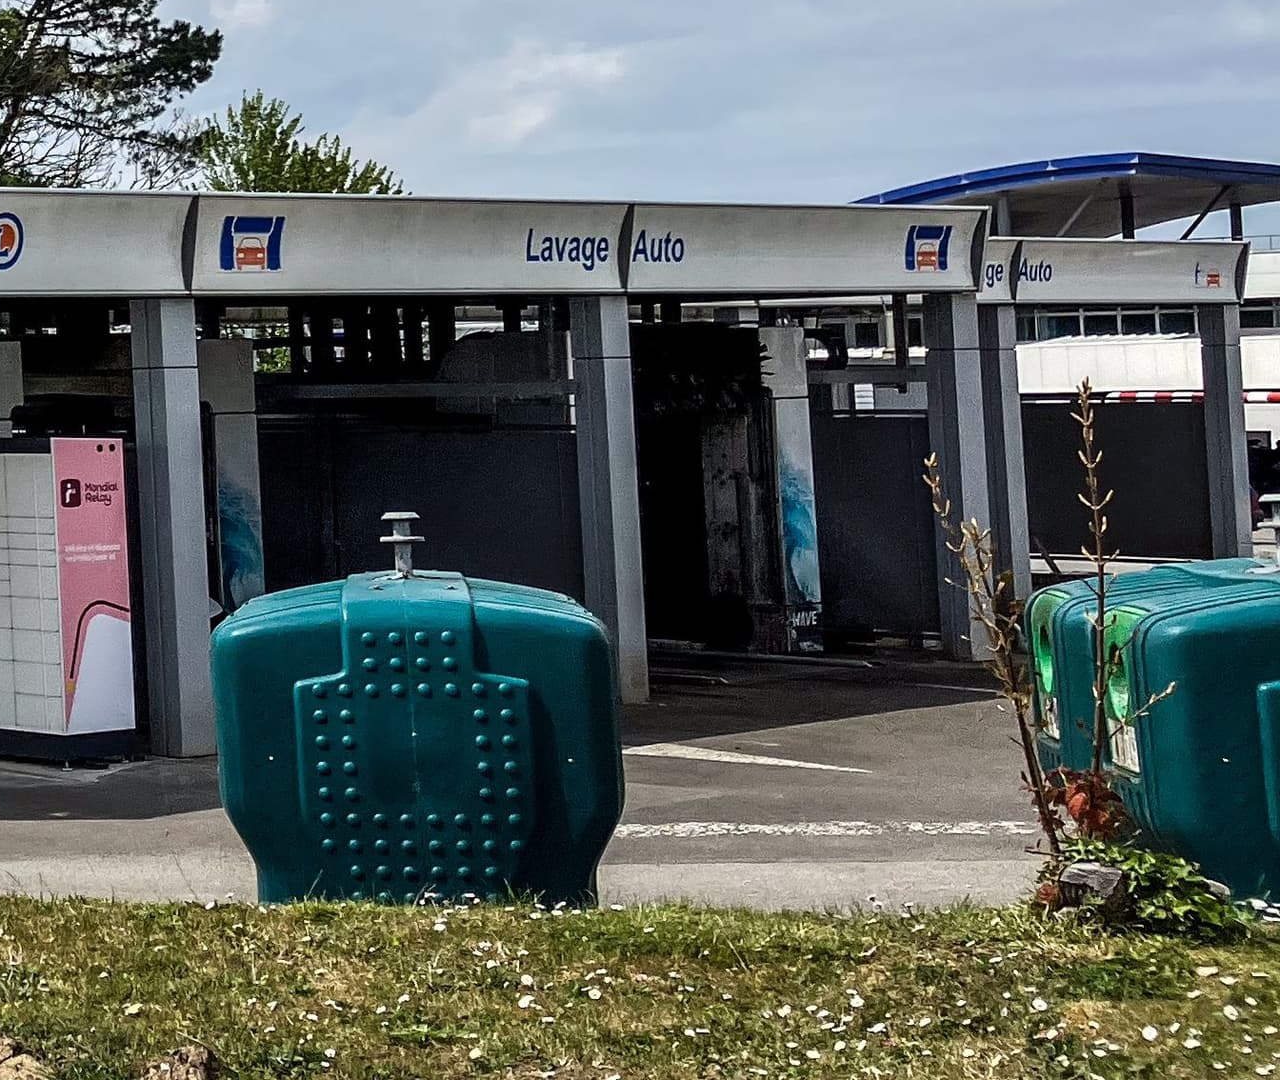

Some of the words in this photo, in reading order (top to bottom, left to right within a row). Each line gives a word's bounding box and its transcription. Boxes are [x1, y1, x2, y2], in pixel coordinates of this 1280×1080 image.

[526, 228, 609, 271] Lavage
[631, 229, 685, 263] Auto
[1017, 257, 1053, 283] Auto
[84, 482, 120, 492] Mondial
[85, 492, 113, 507] Relay
